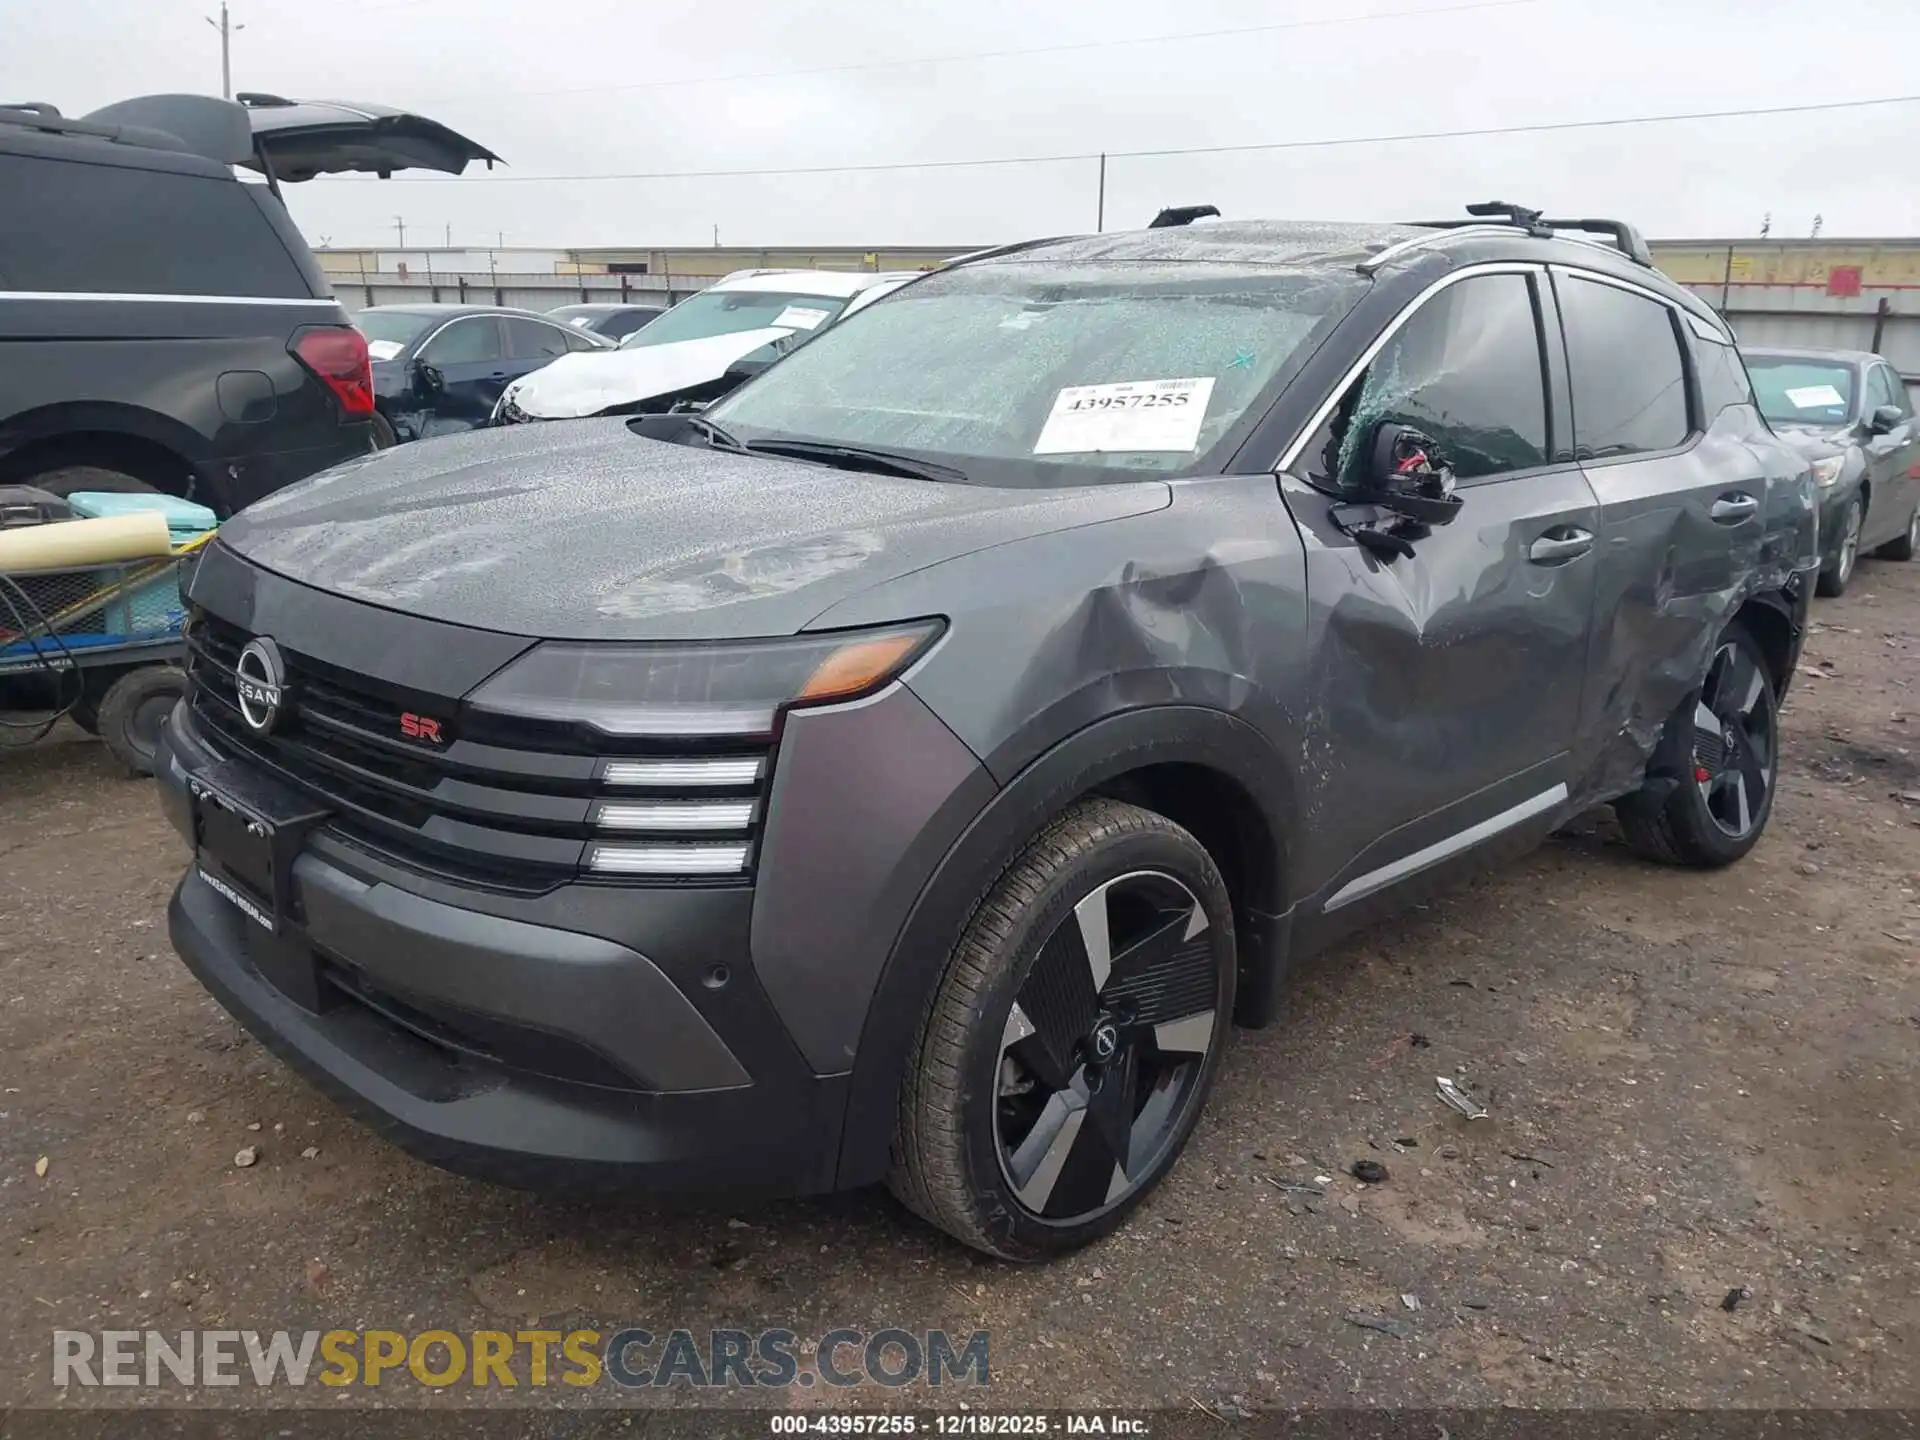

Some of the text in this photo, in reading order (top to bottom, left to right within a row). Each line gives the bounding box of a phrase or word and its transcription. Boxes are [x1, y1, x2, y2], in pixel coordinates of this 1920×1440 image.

[1067, 392, 1189, 411] 43957255
[239, 680, 278, 705] SSAN
[400, 711, 443, 744] SR
